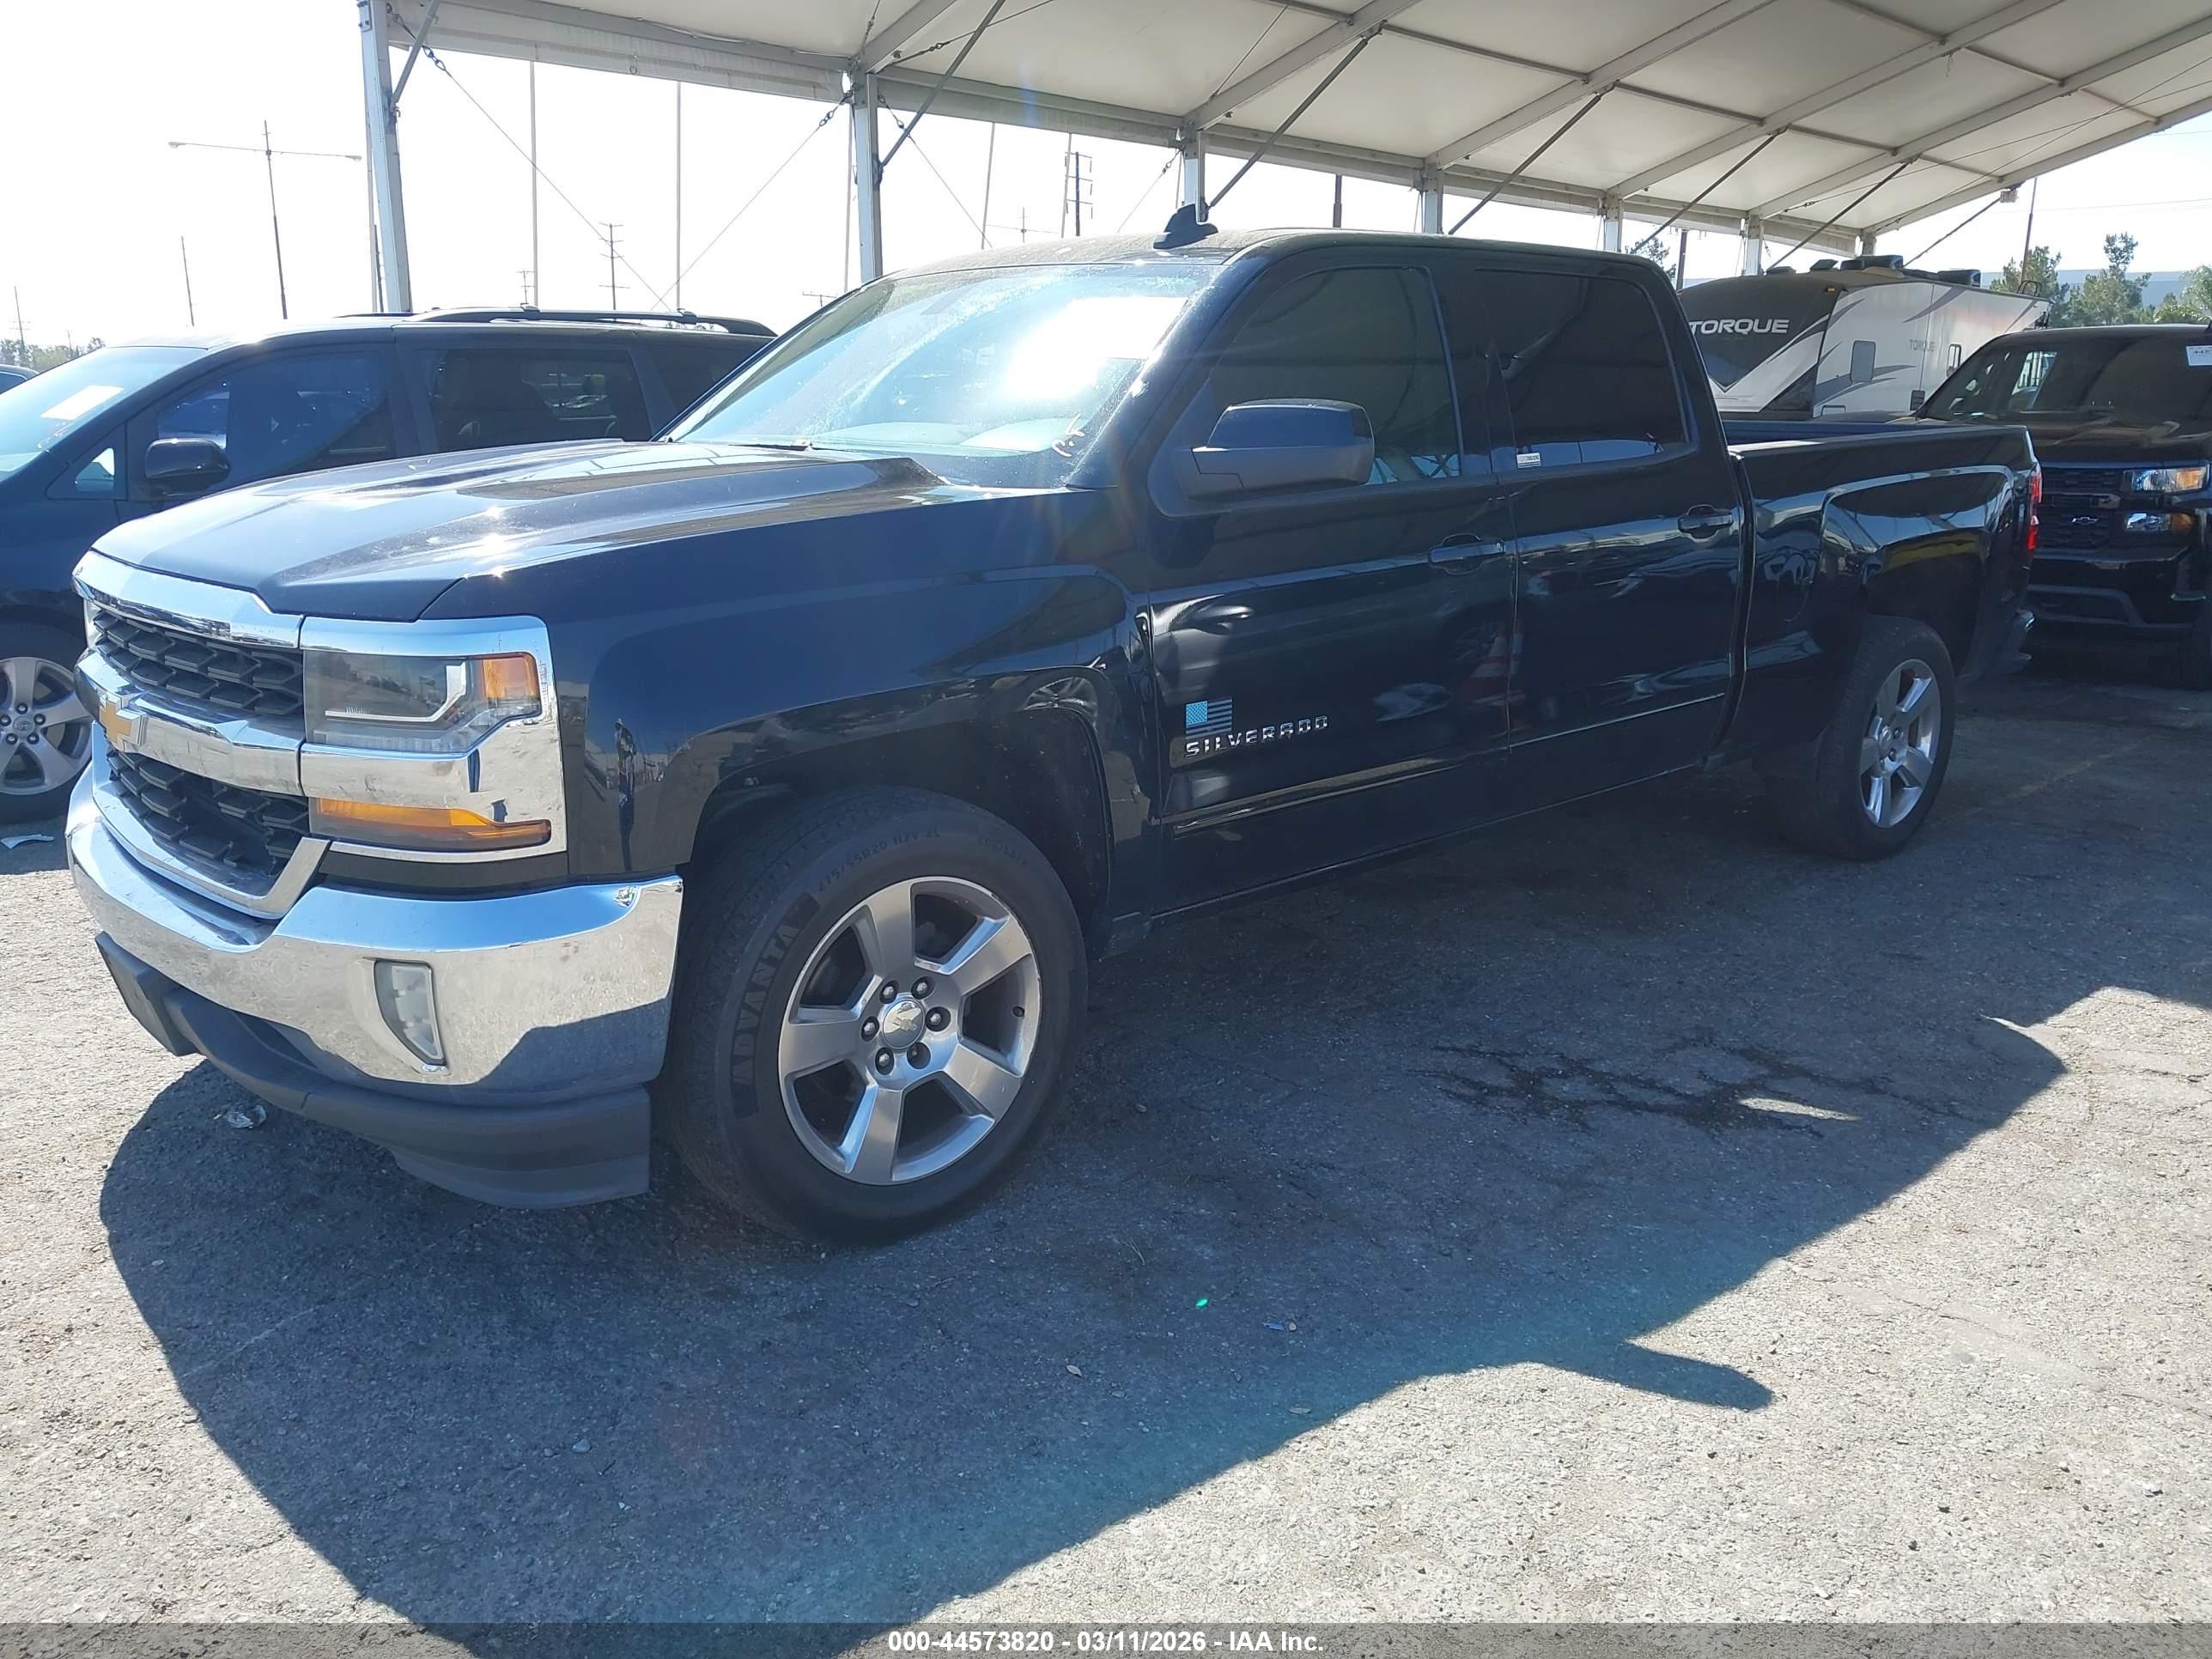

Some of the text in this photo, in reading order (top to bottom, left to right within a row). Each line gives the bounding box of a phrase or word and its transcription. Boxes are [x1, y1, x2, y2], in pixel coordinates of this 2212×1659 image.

[1689, 319, 1790, 335] TORQUE
[1184, 714, 1328, 758] SILVERADO
[732, 923, 800, 1085] ADVANTA
